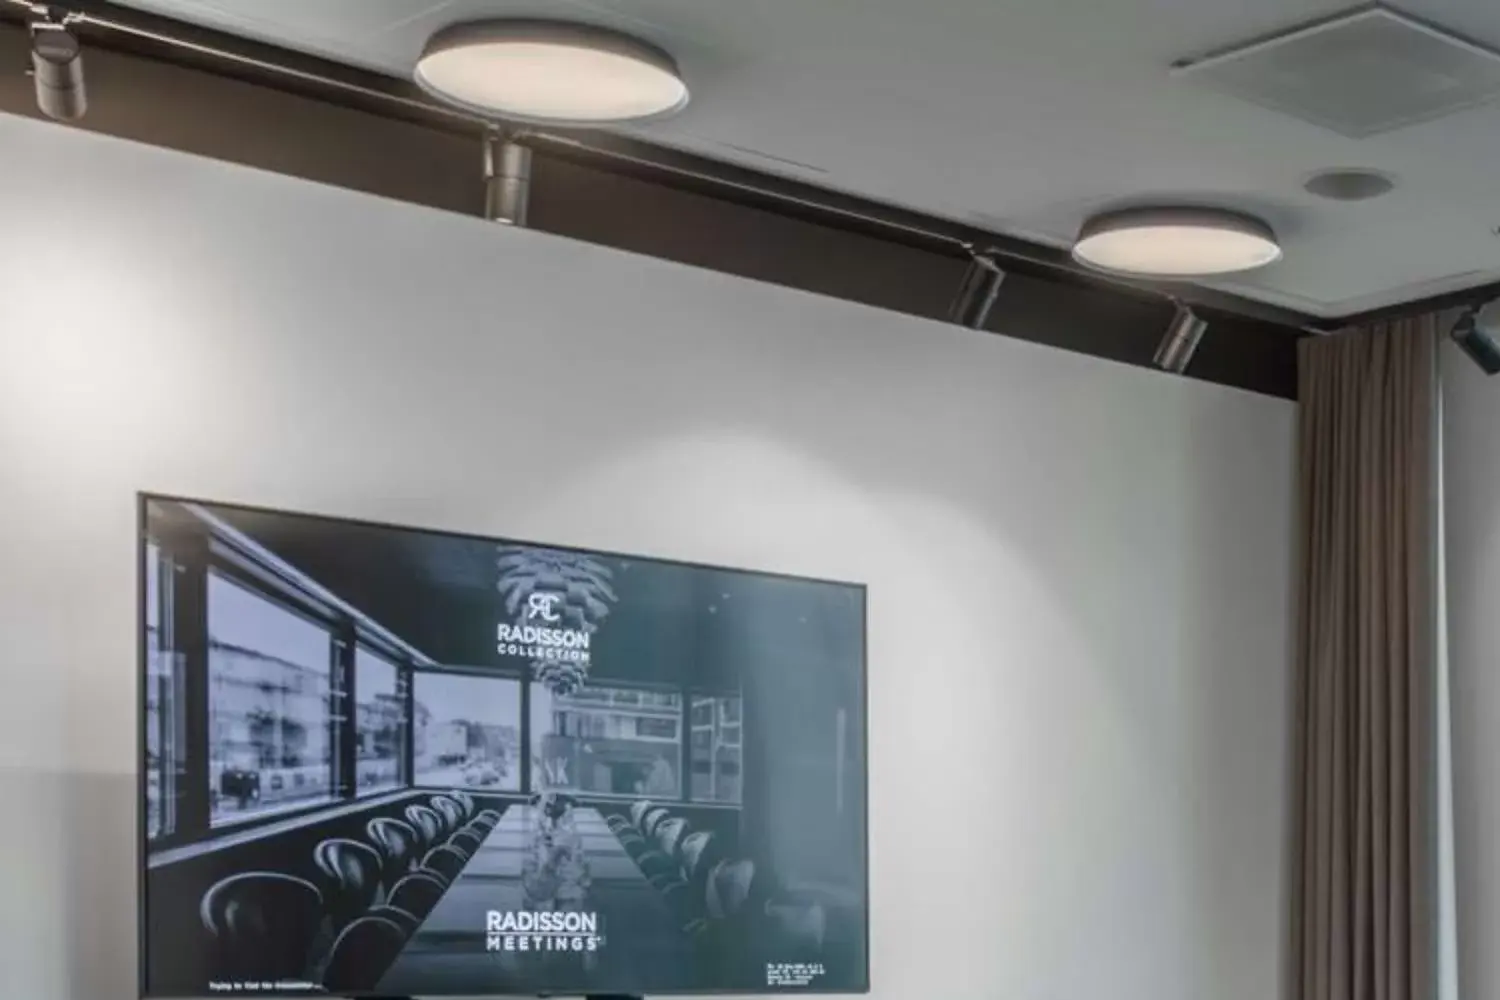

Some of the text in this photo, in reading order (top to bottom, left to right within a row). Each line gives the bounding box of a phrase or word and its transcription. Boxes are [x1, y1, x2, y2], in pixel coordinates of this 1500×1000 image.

[497, 623, 590, 648] RADISSON
[497, 643, 590, 661] COLLECTION
[486, 910, 597, 931] RADISSON
[486, 935, 597, 951] MEETINGS
